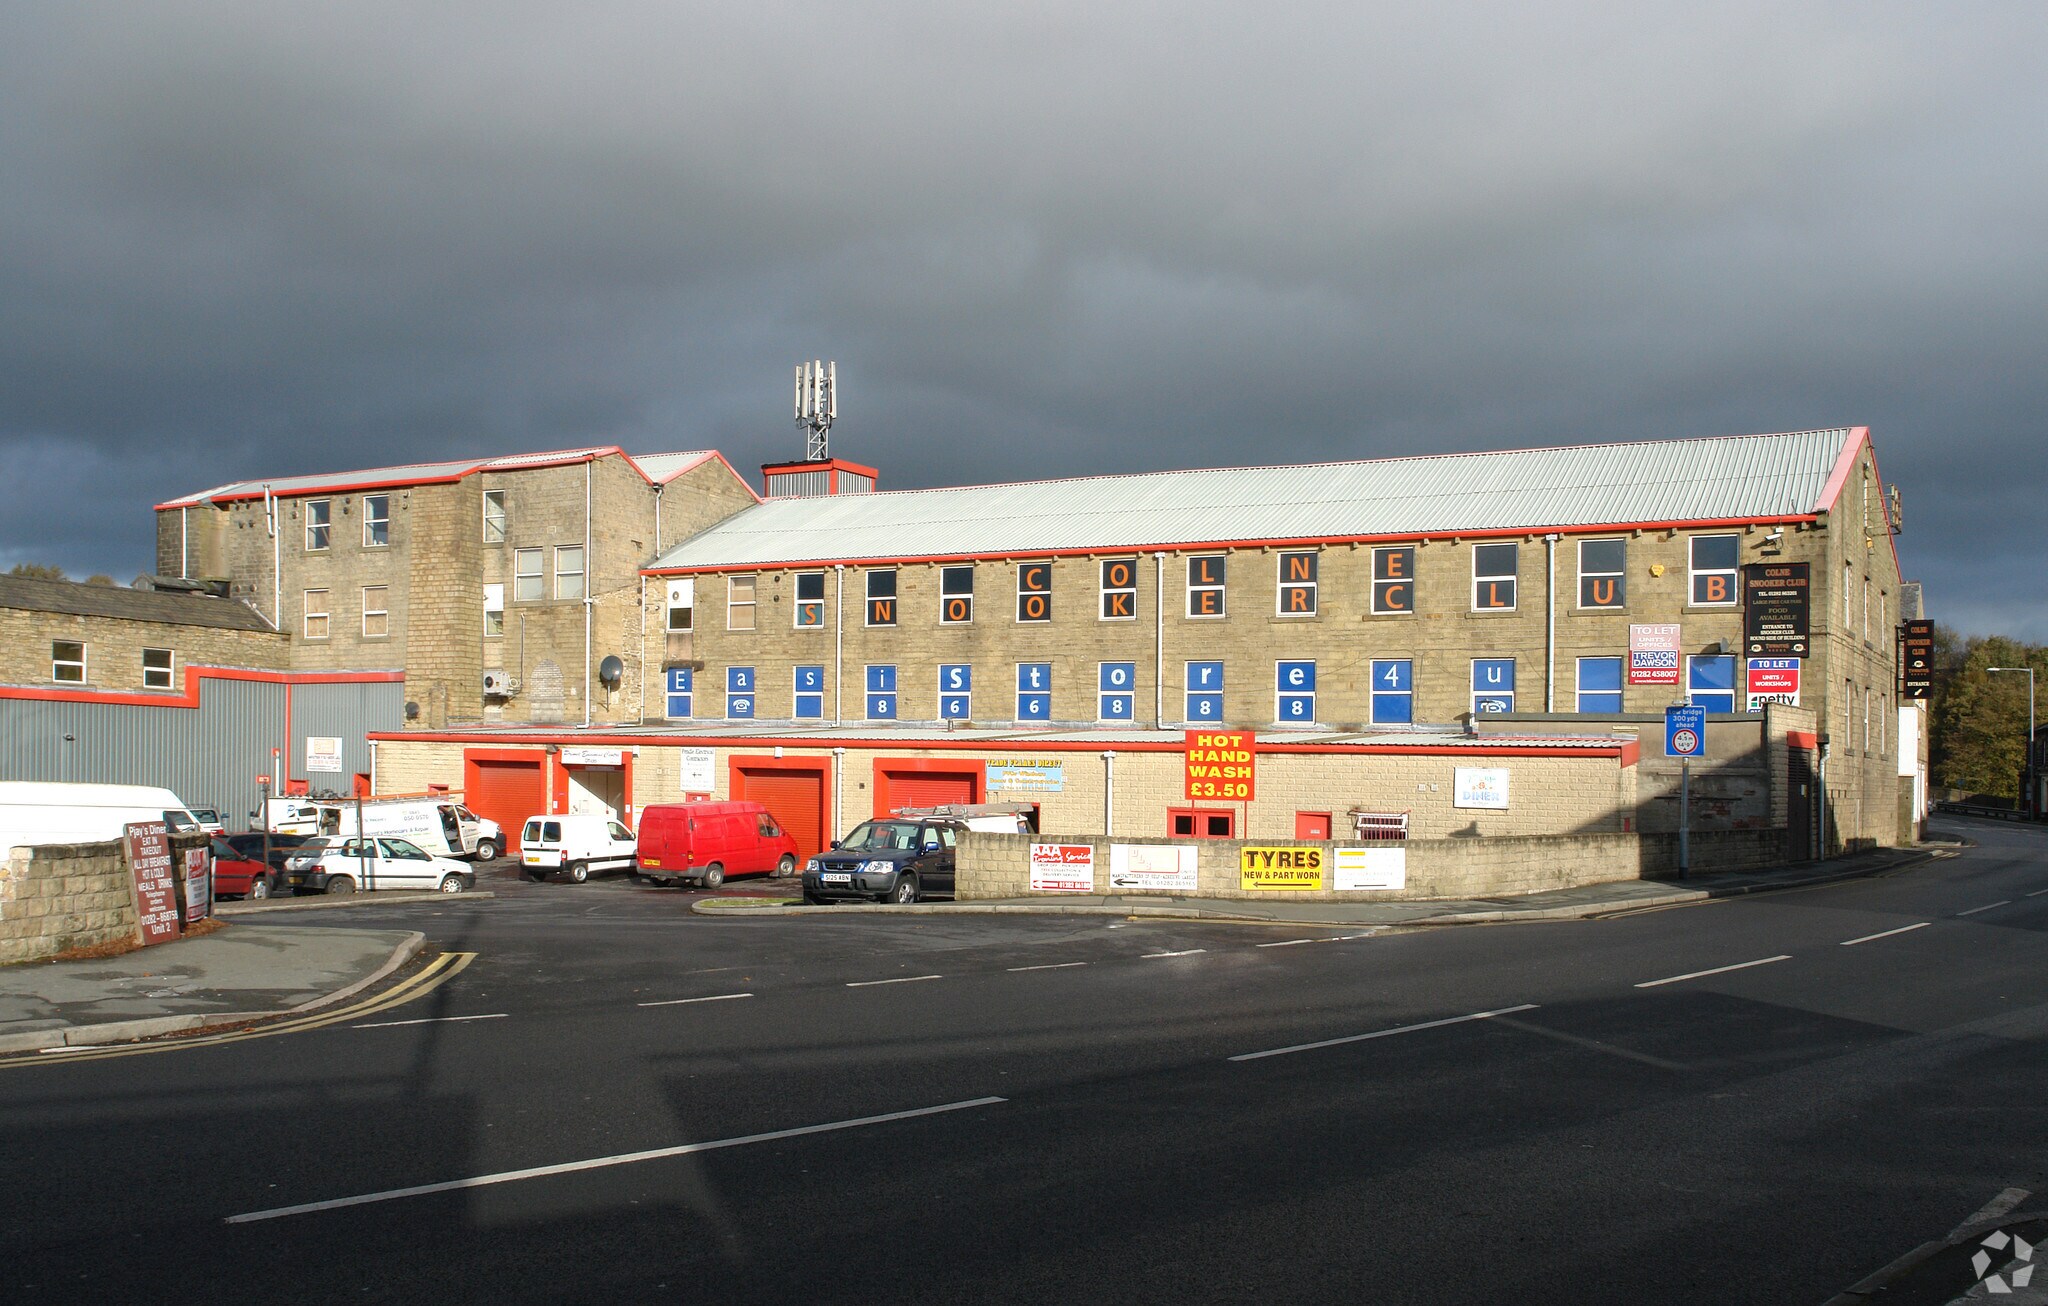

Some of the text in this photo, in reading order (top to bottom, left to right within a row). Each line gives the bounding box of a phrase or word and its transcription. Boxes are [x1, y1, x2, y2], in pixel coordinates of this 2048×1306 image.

[1765, 569, 1791, 577] COLNE
[1749, 578, 1806, 588] SNOOKER CLUB
[1198, 735, 1242, 747] HOT
[1190, 750, 1250, 762] HAND
[1037, 760, 1062, 768] DIRECT
[1189, 766, 1251, 778] WASH
[1190, 783, 1248, 797] £3.50
[1463, 791, 1499, 801] DINER
[129, 825, 166, 839] Pjay's Diner
[142, 837, 151, 845] EAT
[140, 846, 162, 855] TAKEOUT
[1244, 851, 1320, 869] TYRES
[138, 878, 173, 891] MEALS DRINKS
[151, 923, 171, 935] Unit 2
